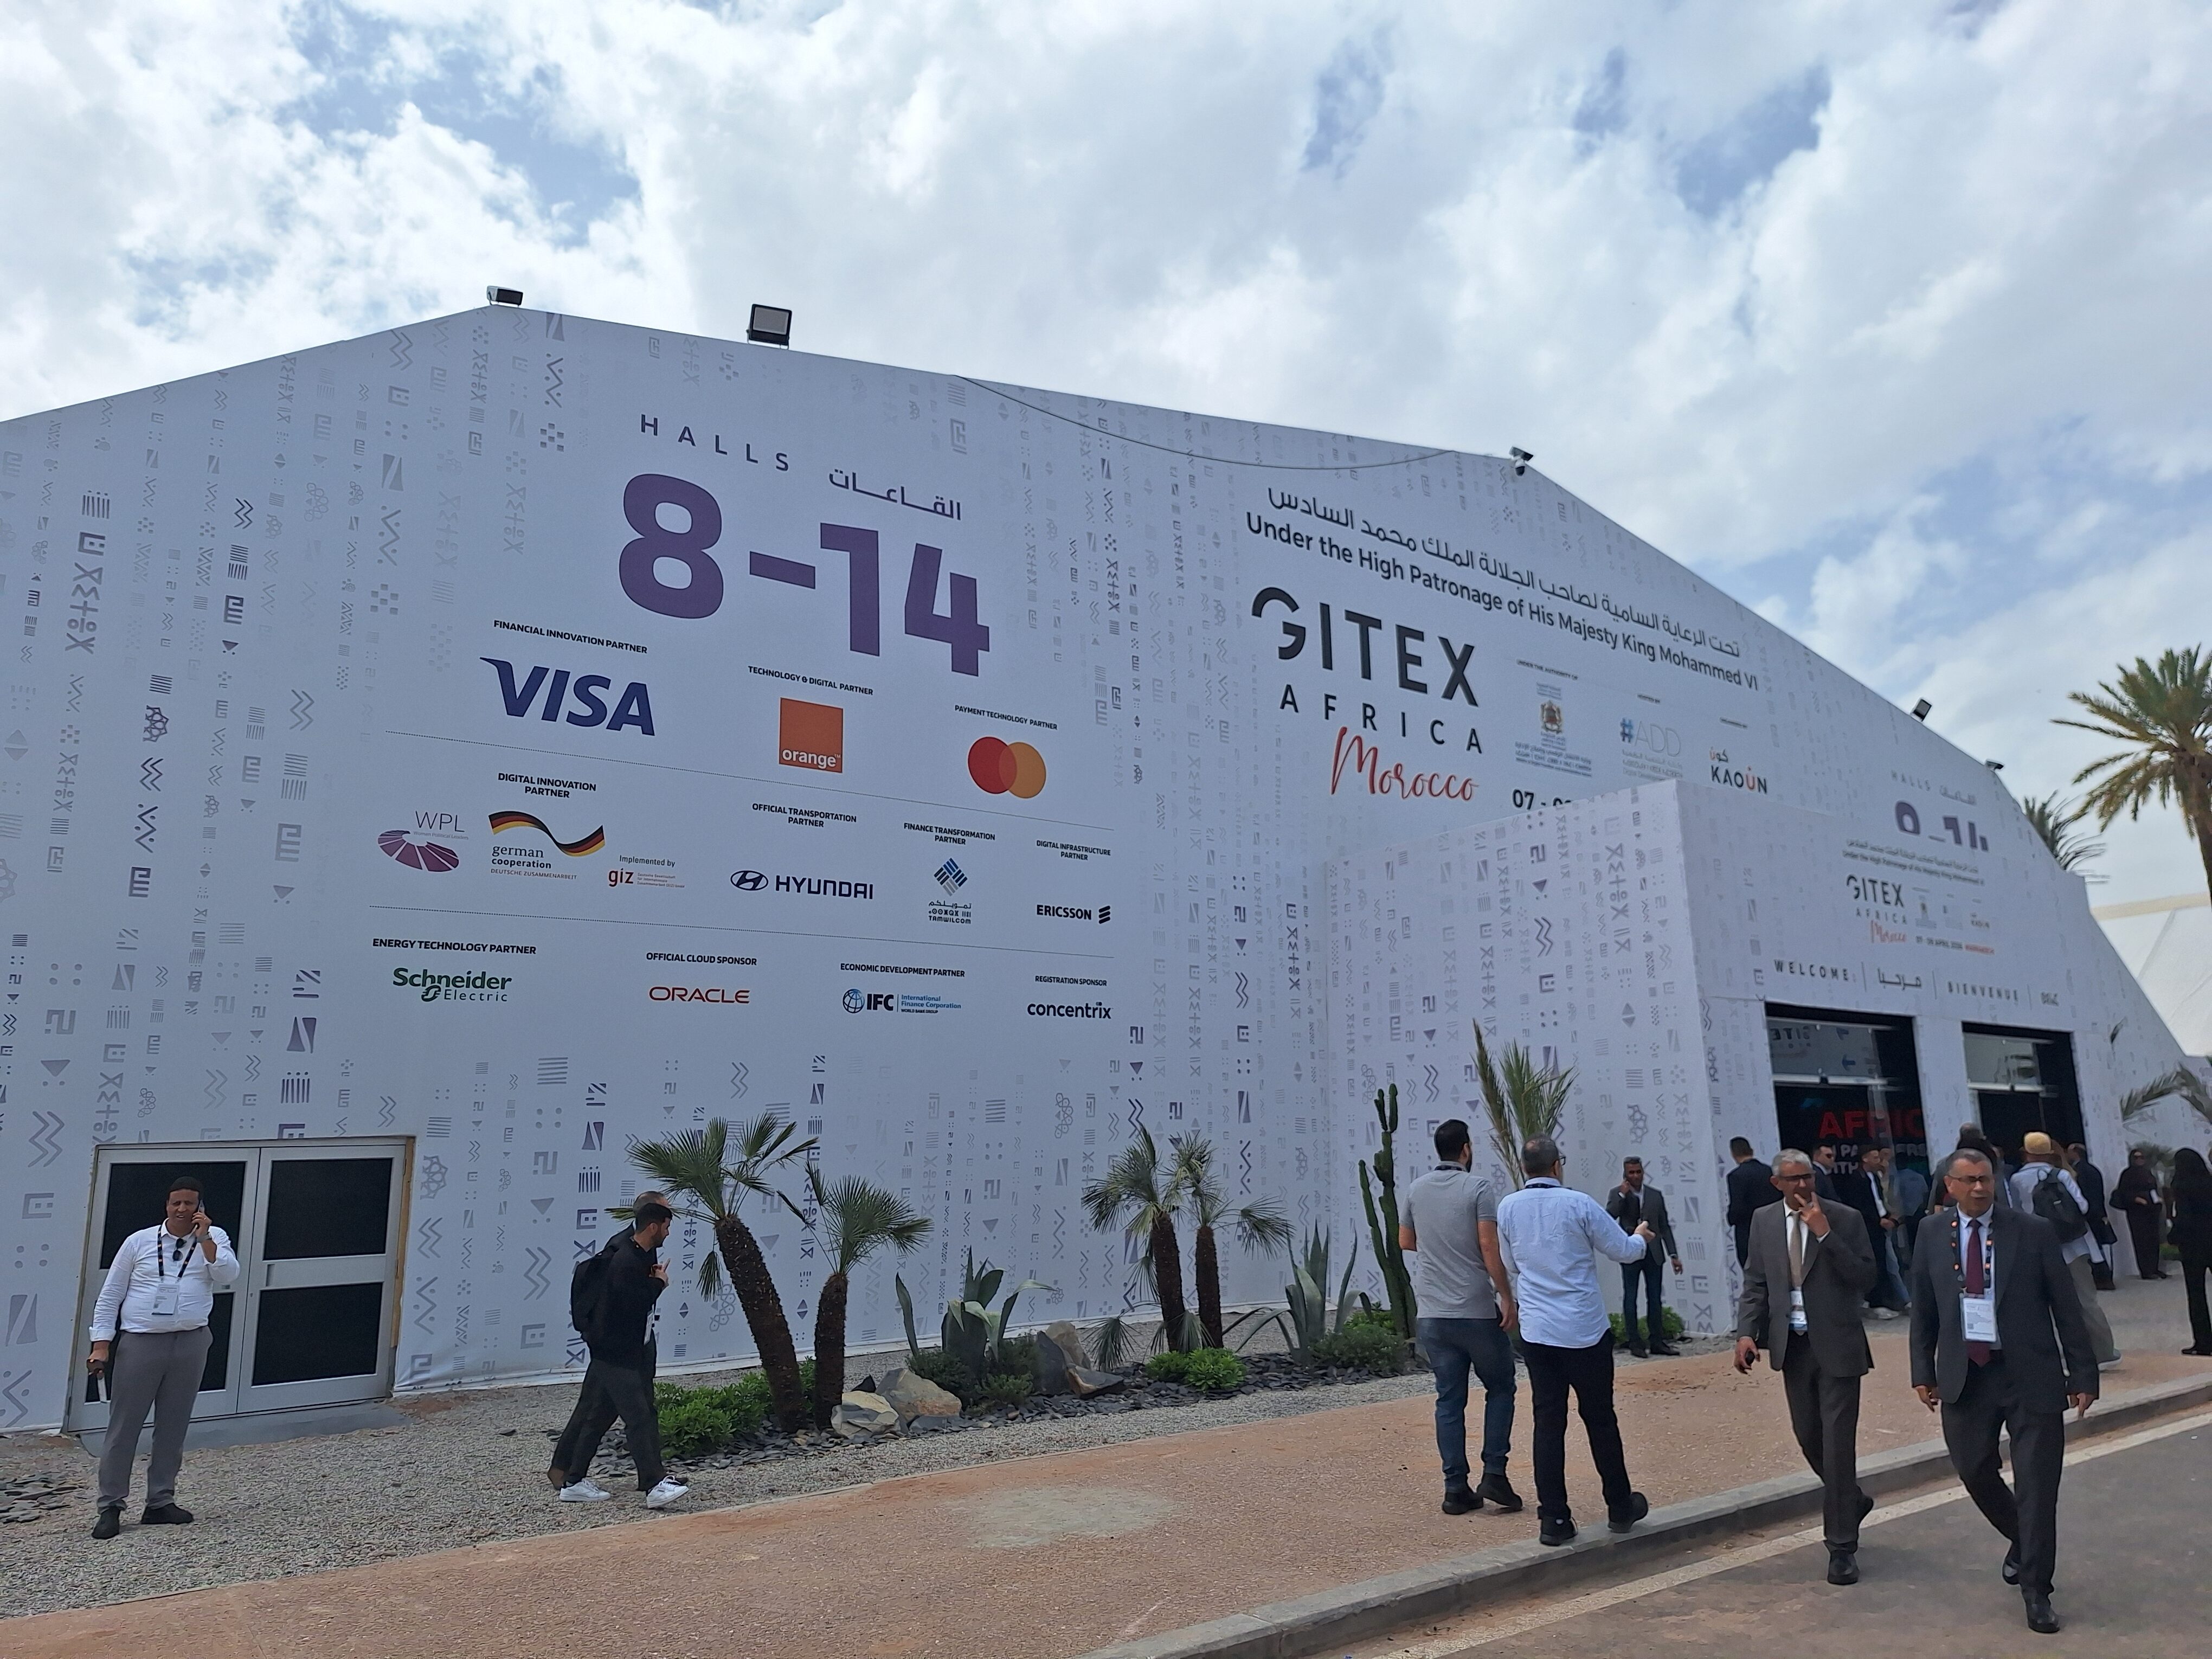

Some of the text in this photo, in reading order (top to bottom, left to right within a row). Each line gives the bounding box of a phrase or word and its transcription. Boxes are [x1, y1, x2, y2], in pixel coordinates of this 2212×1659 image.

[641, 414, 789, 472] HALLS
[1268, 487, 1740, 658] تحت الرعاية السامية لصاحب الجلالة الملك محمد السادس
[1246, 512, 1759, 691] Under the High Patronage of His Majesty King Mohammed VI
[493, 620, 648, 654] FINANCIAL INNOVATION PARTNER
[1251, 587, 1478, 708] GITEX
[748, 666, 801, 682] TECHNOLOGY
[809, 677, 837, 689] DIGITAL
[839, 683, 873, 696] PARTNER
[479, 657, 655, 736] VISA
[955, 704, 1058, 730] PAYMENT TECHNOLOGY PARTNER
[1279, 684, 1482, 754] AFRICA
[782, 749, 837, 769] orange
[1330, 726, 1479, 801] Morocco
[498, 773, 597, 792] DIGITAL INNOVATION
[524, 786, 570, 798] PARTNER
[1512, 789, 1534, 810] 07
[415, 811, 465, 833] WPL
[752, 803, 857, 822] OFFICIAL TRANSPORTATION
[788, 816, 824, 828] PARTNER
[904, 822, 995, 841] FINANCE TRANSFORMATION
[935, 835, 966, 845] PARTNER
[492, 845, 544, 858] german
[1037, 840, 1111, 856] DIGITAL INFRASTRUCTURE
[1060, 851, 1088, 860] PARTNER
[491, 858, 552, 870] cooperation
[619, 854, 676, 868] Implemented by
[523, 870, 577, 880] ZUSAMMENARBEIT
[608, 867, 634, 888] giz
[775, 875, 873, 899] HYUNDAI
[1846, 873, 1905, 908] GITEX
[928, 915, 971, 924] TAMWILCOM
[1037, 904, 1092, 920] ERICSSON
[372, 938, 536, 954] ENERGY TECHNOLOGY PARTNER
[646, 952, 757, 966] OFFICIAL CLOUD SPONSOR
[393, 967, 512, 990] Schneider
[840, 963, 965, 978] ECONOMIC DEVELOPMENT PARTNER
[1773, 959, 1848, 981] WELCOME
[1035, 975, 1107, 987] REGISTRATION SPONSOR
[444, 989, 507, 1002] Electric
[649, 986, 750, 1004] ORACLE
[866, 993, 894, 1011] IFC
[901, 994, 941, 1002] International
[1027, 1001, 1111, 1019] concentrix
